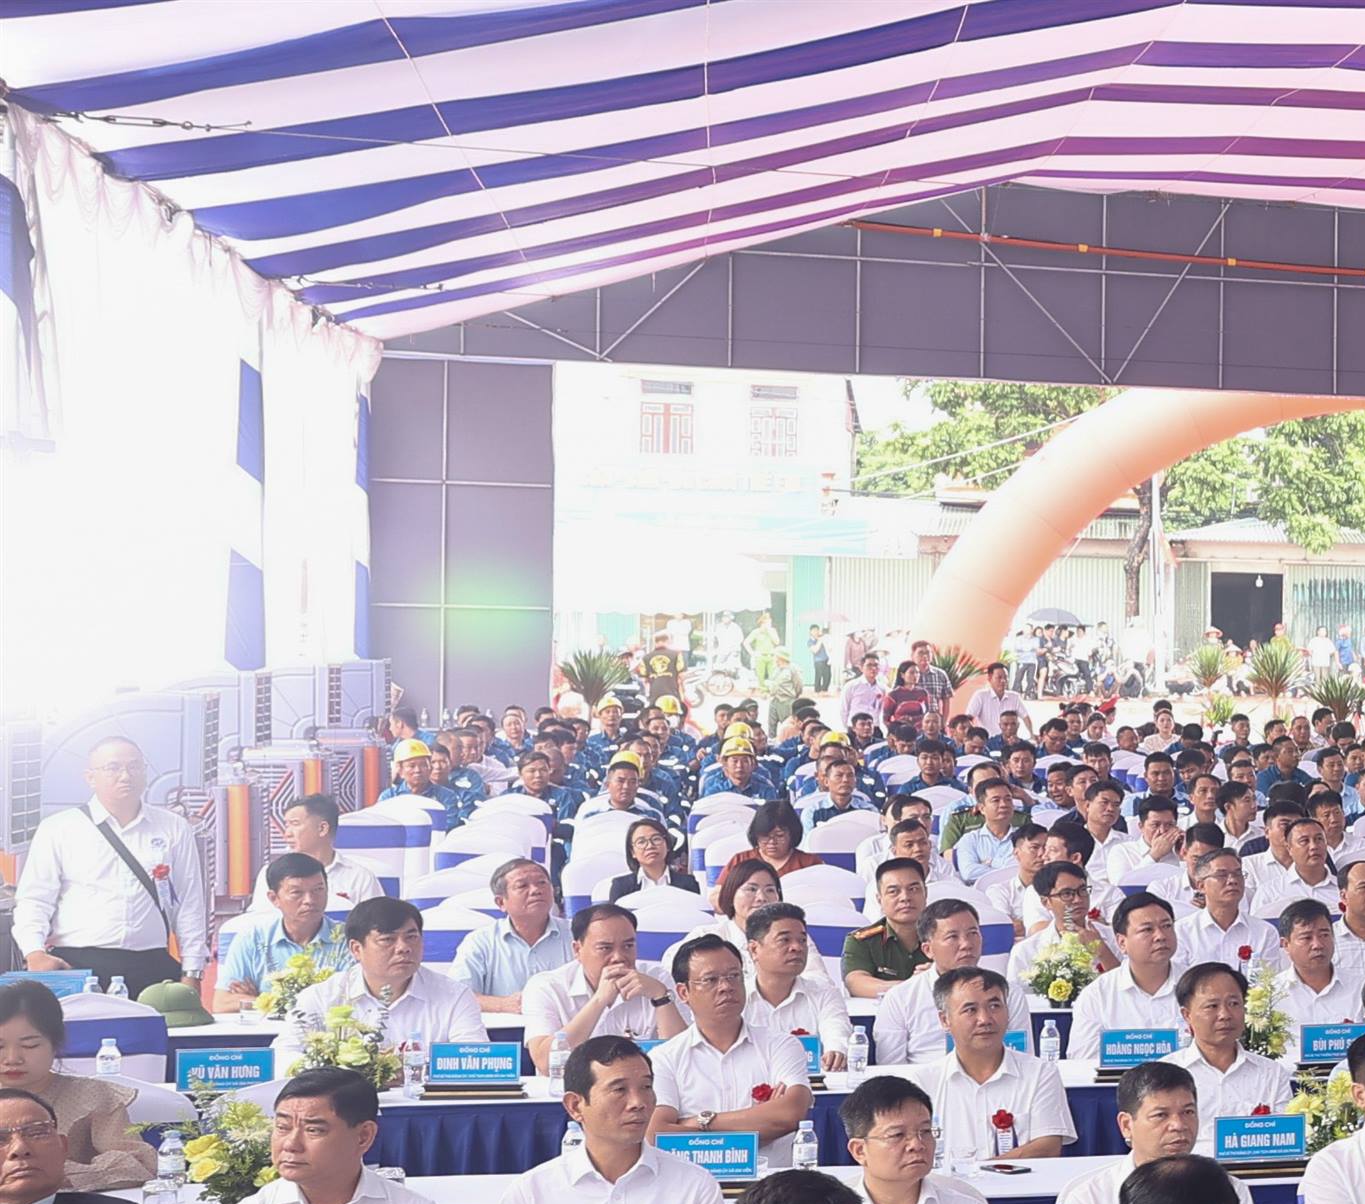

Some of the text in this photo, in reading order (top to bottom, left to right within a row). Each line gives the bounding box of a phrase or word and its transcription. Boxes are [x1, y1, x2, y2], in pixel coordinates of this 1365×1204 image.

[459, 1046, 478, 1054] ĐỒNG
[1106, 1040, 1171, 1057] HOÀNG NGỌC HÒA
[1313, 1037, 1327, 1051] BÙI
[1328, 1037, 1345, 1050] PHÚ
[209, 1054, 230, 1062] ĐỒNG
[436, 1055, 512, 1073] ĐINH VĂN PHỤNG
[207, 1064, 229, 1079] VĂN
[231, 1065, 260, 1078] HƯNG
[688, 1137, 724, 1146] ĐỒNG CHÍ
[1225, 1132, 1296, 1149] HÀ GIANG NAM
[692, 1149, 723, 1164] THANH
[724, 1147, 748, 1163] BÌNH
